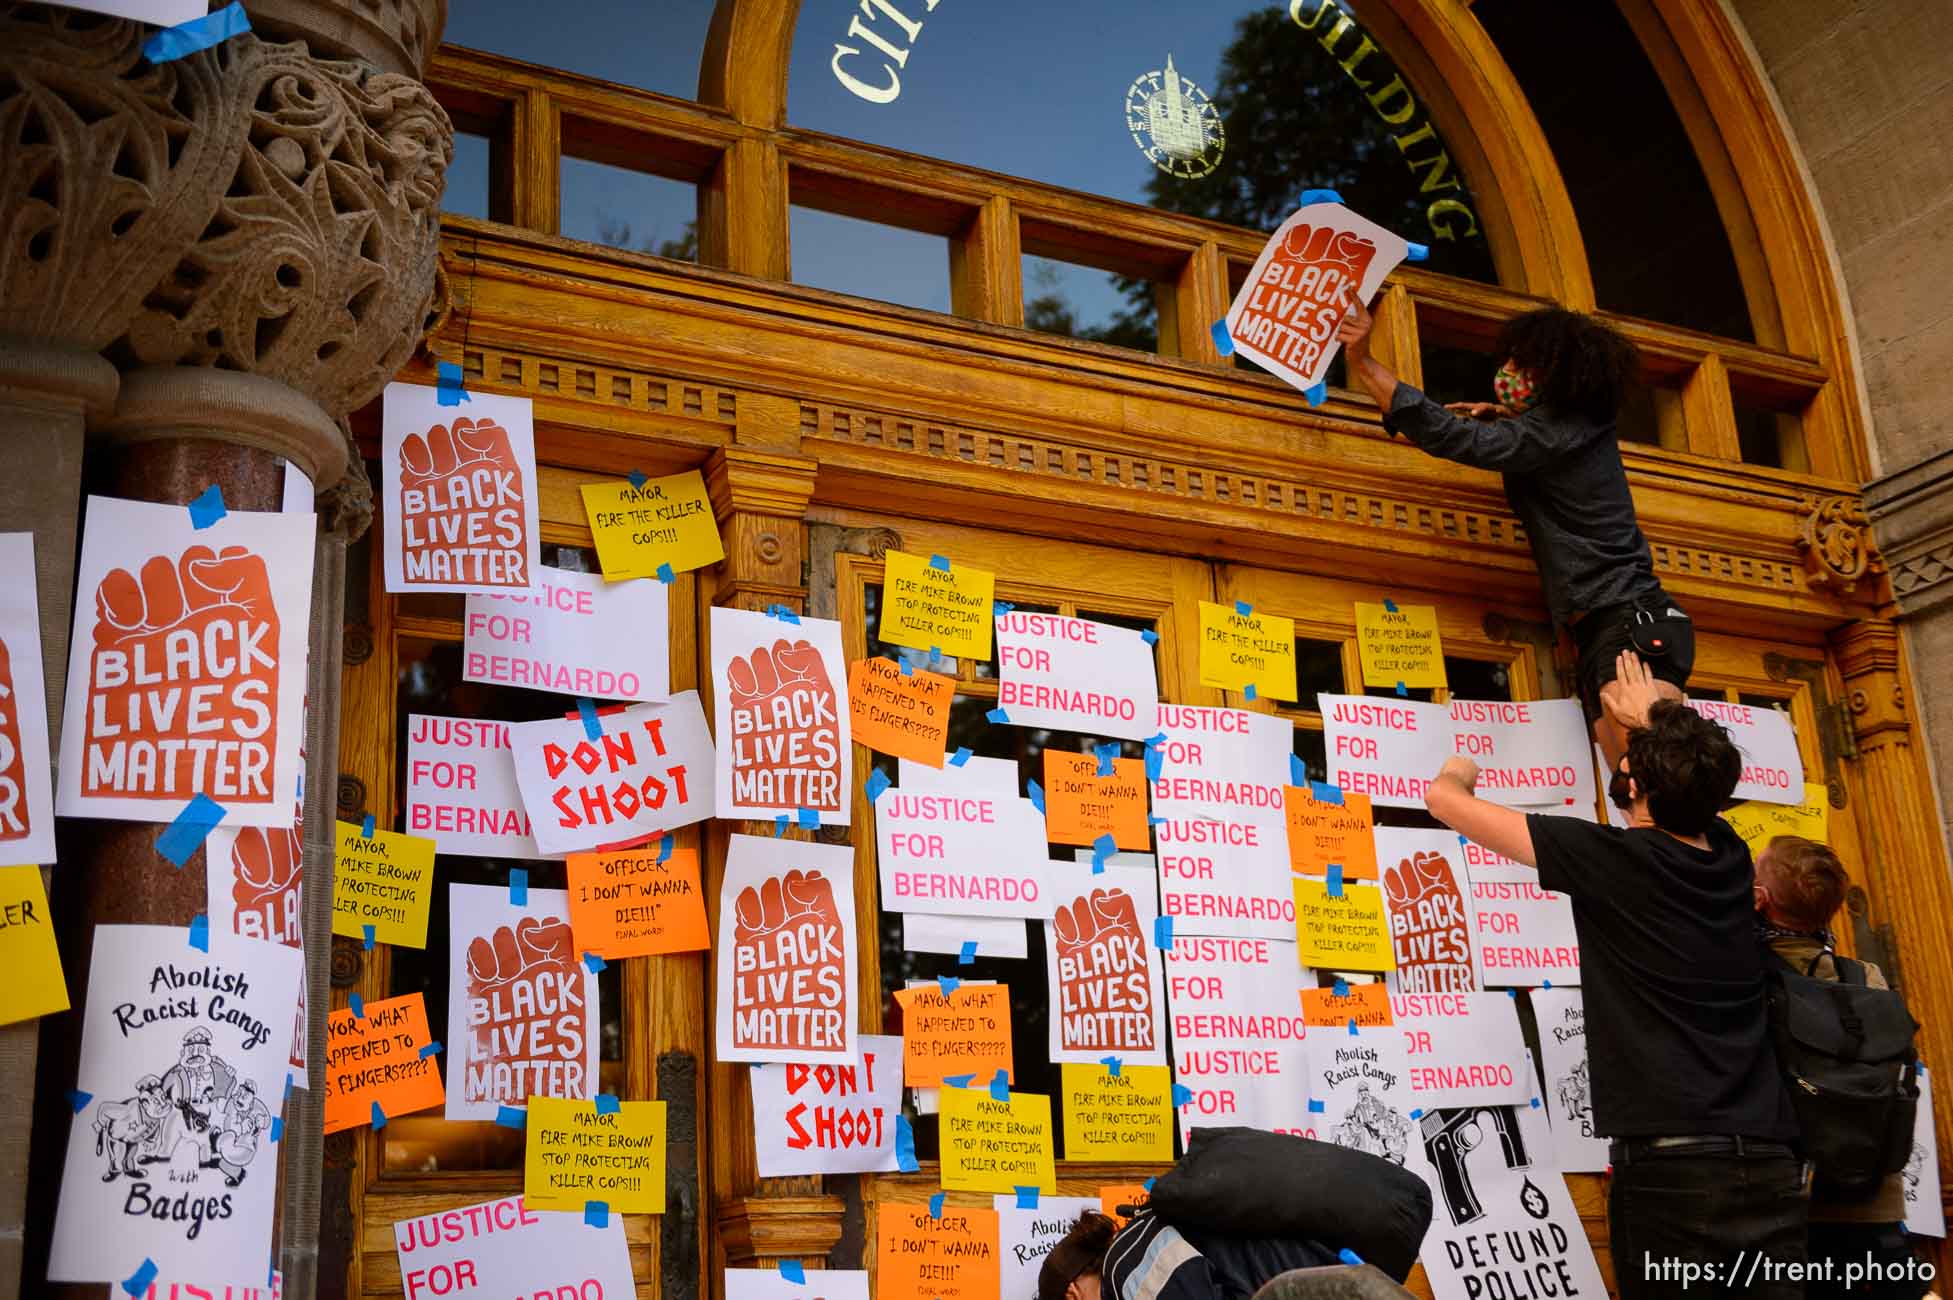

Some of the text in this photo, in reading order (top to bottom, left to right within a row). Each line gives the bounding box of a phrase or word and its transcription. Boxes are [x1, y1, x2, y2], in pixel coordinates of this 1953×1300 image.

[1261, 261, 1356, 308] BLACK
[1249, 285, 1338, 342] LIVES
[1236, 310, 1319, 376] MATTER
[404, 469, 521, 515] BLACK
[620, 485, 668, 503] MAYOR,
[405, 508, 521, 548] LIVES
[596, 500, 705, 528] FIRE THE KILLER
[632, 527, 679, 546] COPS!!!
[406, 548, 526, 584] MATTER
[896, 578, 983, 608] FIRE MIKE BROWN
[896, 597, 980, 625] STOP PROTECTING
[900, 617, 932, 632] KILLER
[469, 613, 531, 643] FOR
[997, 614, 1098, 644] JUSTICE
[1206, 627, 1289, 656] FIRE THE KILLER
[96, 620, 276, 688] BLACK
[1000, 646, 1051, 672] FOR
[468, 652, 639, 697] BERNARDO
[864, 658, 944, 696] MAYOR, WHAT
[93, 679, 271, 739] LIVES
[734, 689, 836, 735] BLACK
[861, 679, 935, 717] HAPPENED TO
[1001, 681, 1135, 721] BERNARDO
[852, 696, 941, 741] HIS FINGERS????
[1157, 706, 1250, 734] JUSTICE
[1333, 704, 1417, 731] JUSTICE
[1450, 702, 1531, 724] JUSTICE
[735, 729, 836, 769] LIVES
[1336, 735, 1377, 760] FOR
[1456, 734, 1494, 756] FOR
[88, 739, 269, 796] MATTER
[413, 760, 476, 790] FOR
[1475, 766, 1576, 789] ERNARDO
[552, 765, 689, 828] SHOOT
[735, 768, 838, 806] MATTER
[1099, 785, 1138, 800] WANNA
[1155, 778, 1282, 810] BERNARDO
[888, 796, 994, 823] JUSTICE
[891, 834, 944, 859] FOR
[1160, 820, 1258, 847] JUSTICE
[345, 837, 390, 859] MAYOR,
[341, 858, 422, 882] MIKE BROWN
[1163, 857, 1213, 880] FOR
[343, 878, 416, 904] PROTECTING
[580, 880, 693, 902] I DON'T WANNA
[895, 872, 1039, 902] BERNARDO
[363, 904, 405, 923] COPS!!!
[1166, 893, 1295, 922] BERNARDO
[1392, 893, 1464, 936] BLACK
[1477, 912, 1520, 934] FOR
[737, 923, 842, 971] BLACK
[1060, 935, 1146, 981] BLACK
[1168, 939, 1269, 963] JUSTICE
[1395, 927, 1468, 964] LIVES
[150, 964, 248, 998] Abolish
[736, 965, 842, 1008] LIVES
[1172, 976, 1223, 1000] FOR
[1397, 963, 1475, 993] MATTER
[471, 972, 583, 1025] BLACK
[914, 993, 996, 1011] MAYOR, WHAT
[1063, 972, 1148, 1013] LIVES
[1393, 995, 1469, 1017] USTICE
[113, 997, 199, 1038] Racist
[208, 995, 271, 1050] Gangs
[371, 1005, 412, 1029] WHAT
[736, 1008, 843, 1048] MATTER
[917, 1017, 995, 1033] HAPPENED TO
[1063, 1011, 1152, 1048] MATTER
[1176, 1015, 1306, 1041] BERNARDO
[393, 1034, 413, 1050] TO
[470, 1016, 581, 1061] LIVES
[911, 1040, 1006, 1057] HIS FINGERS????
[1179, 1051, 1280, 1075] JUSTICE
[1335, 1047, 1378, 1064] Abolish
[339, 1059, 429, 1094] FINGERS????
[469, 1061, 583, 1101] MATTER
[1324, 1062, 1397, 1089] Racist Gangs
[1411, 1064, 1512, 1091] ERNARDO
[1073, 1093, 1162, 1108] FIRE MIKE BROWN
[1183, 1090, 1236, 1115] FOR
[574, 1113, 618, 1130] MAYOR,
[785, 1102, 884, 1150] SHOOT
[951, 1118, 1042, 1137] FIRE MIKE BROWN
[1076, 1112, 1162, 1127] STOP PROTECTING
[540, 1130, 653, 1149] FIRE MIKE BROWN
[953, 1138, 1042, 1155] STOP PROTECTING
[1083, 1131, 1118, 1145] KILLER
[542, 1152, 649, 1170] STOP PROTECTING
[960, 1158, 997, 1172] KILLER
[550, 1175, 641, 1191] KILLER COPS!!!
[124, 1182, 232, 1240] Badges
[400, 1198, 539, 1254] JUSTICE
[889, 1239, 990, 1256] I DON'T WANNA
[1445, 1222, 1568, 1270] DEFUND
[406, 1260, 477, 1300] FOR
[1463, 1259, 1579, 1300] POLICE
